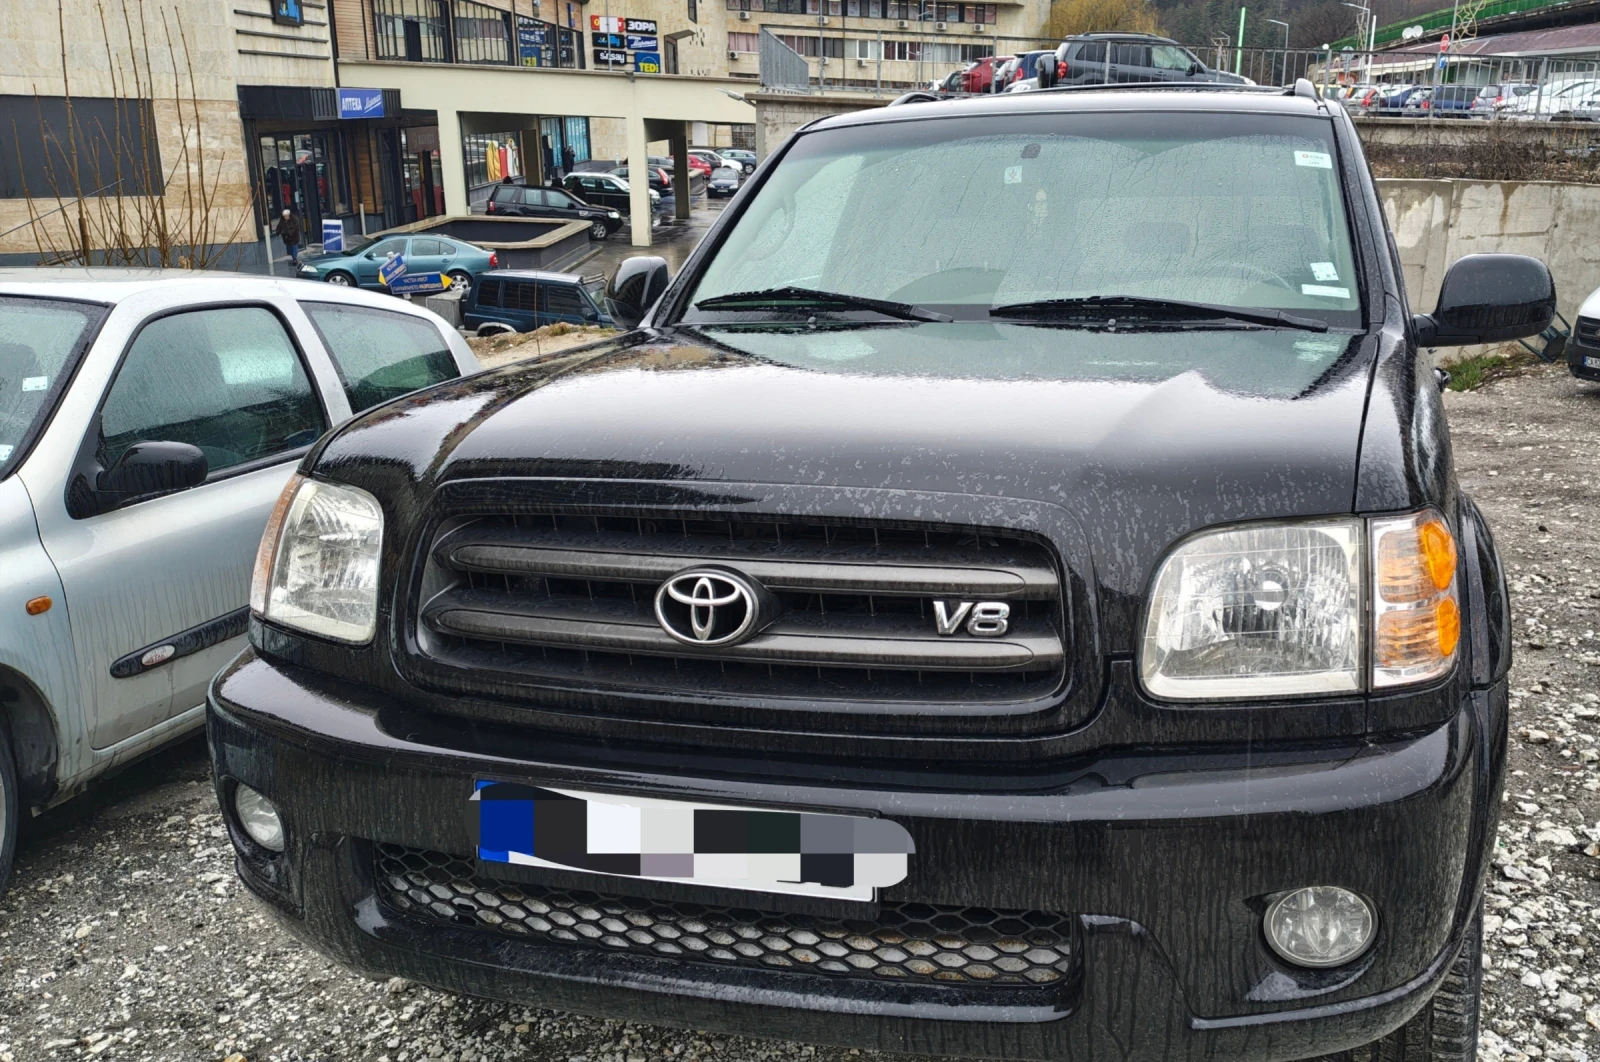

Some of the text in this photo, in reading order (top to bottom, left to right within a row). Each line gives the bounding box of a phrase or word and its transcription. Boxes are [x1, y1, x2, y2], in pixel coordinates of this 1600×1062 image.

[627, 20, 656, 32] ЗОРА
[639, 63, 659, 73] TEDi
[341, 97, 362, 111] АПТЕКА
[933, 600, 1010, 637] V8
